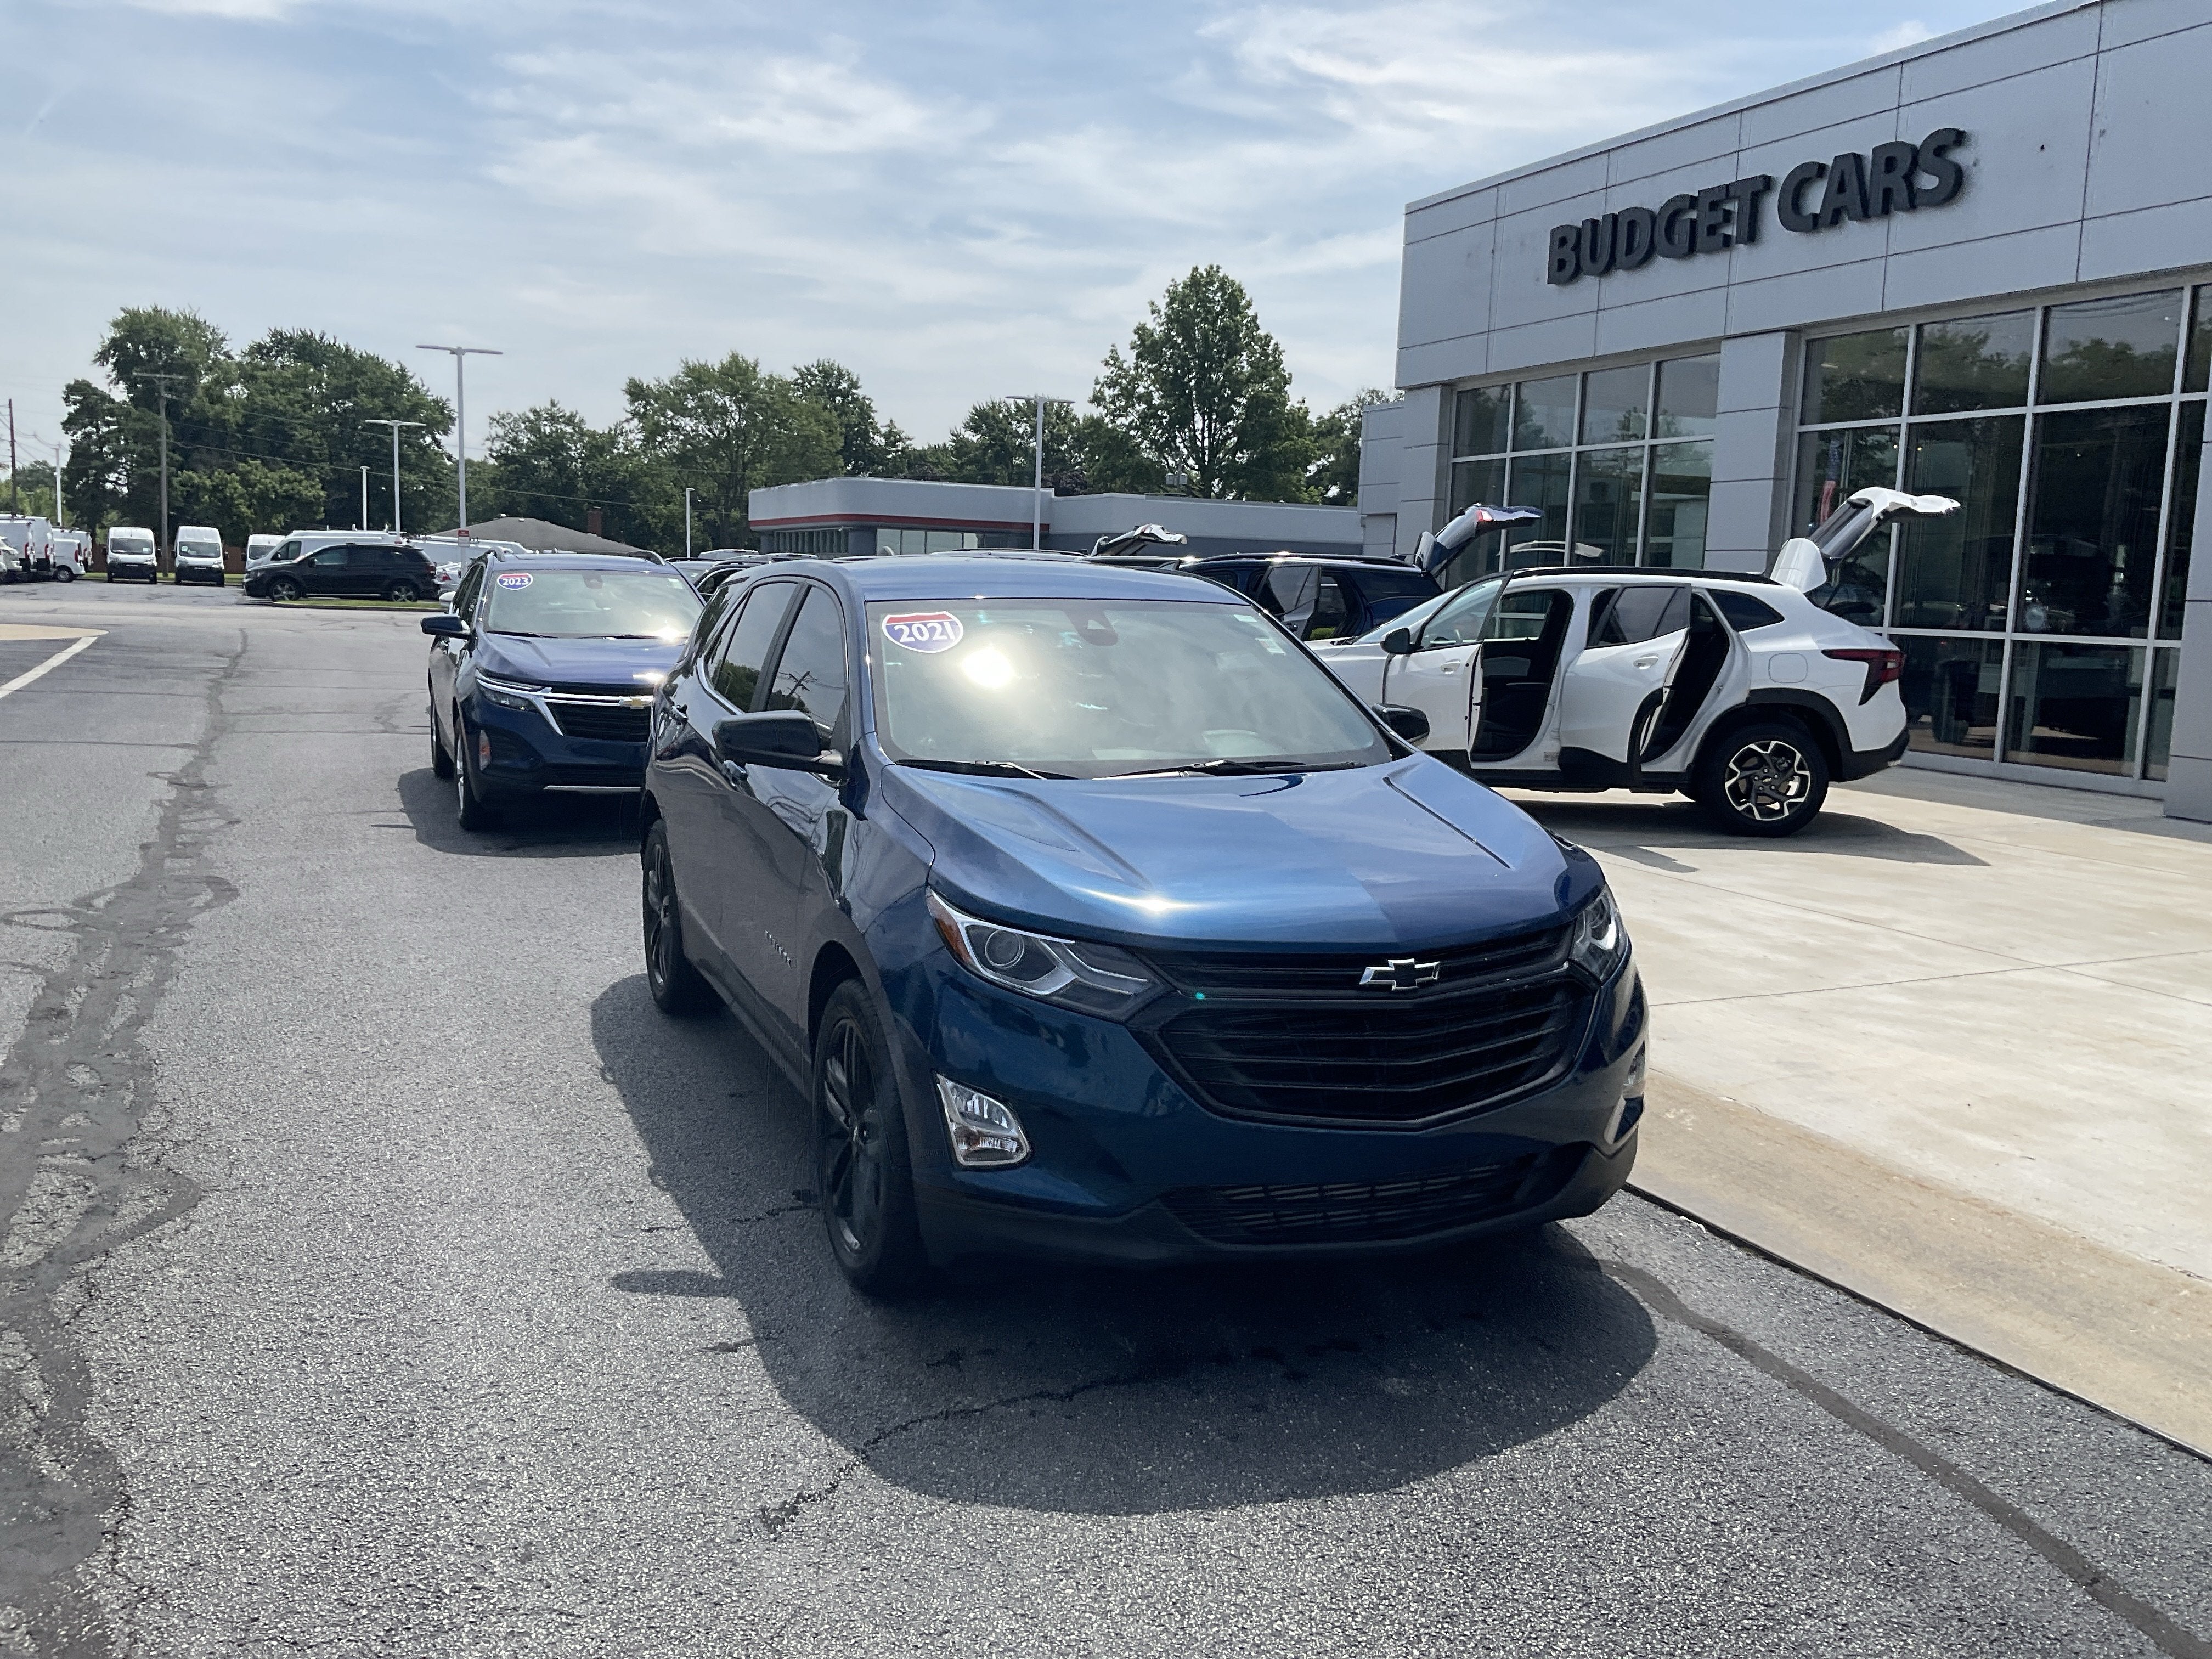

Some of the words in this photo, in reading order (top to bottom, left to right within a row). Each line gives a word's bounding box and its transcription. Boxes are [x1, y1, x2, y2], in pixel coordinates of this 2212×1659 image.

[1547, 174, 1771, 284] BUDGET
[1778, 128, 1966, 232] CARS
[501, 577, 529, 586] 2023
[894, 621, 956, 642] 2021
